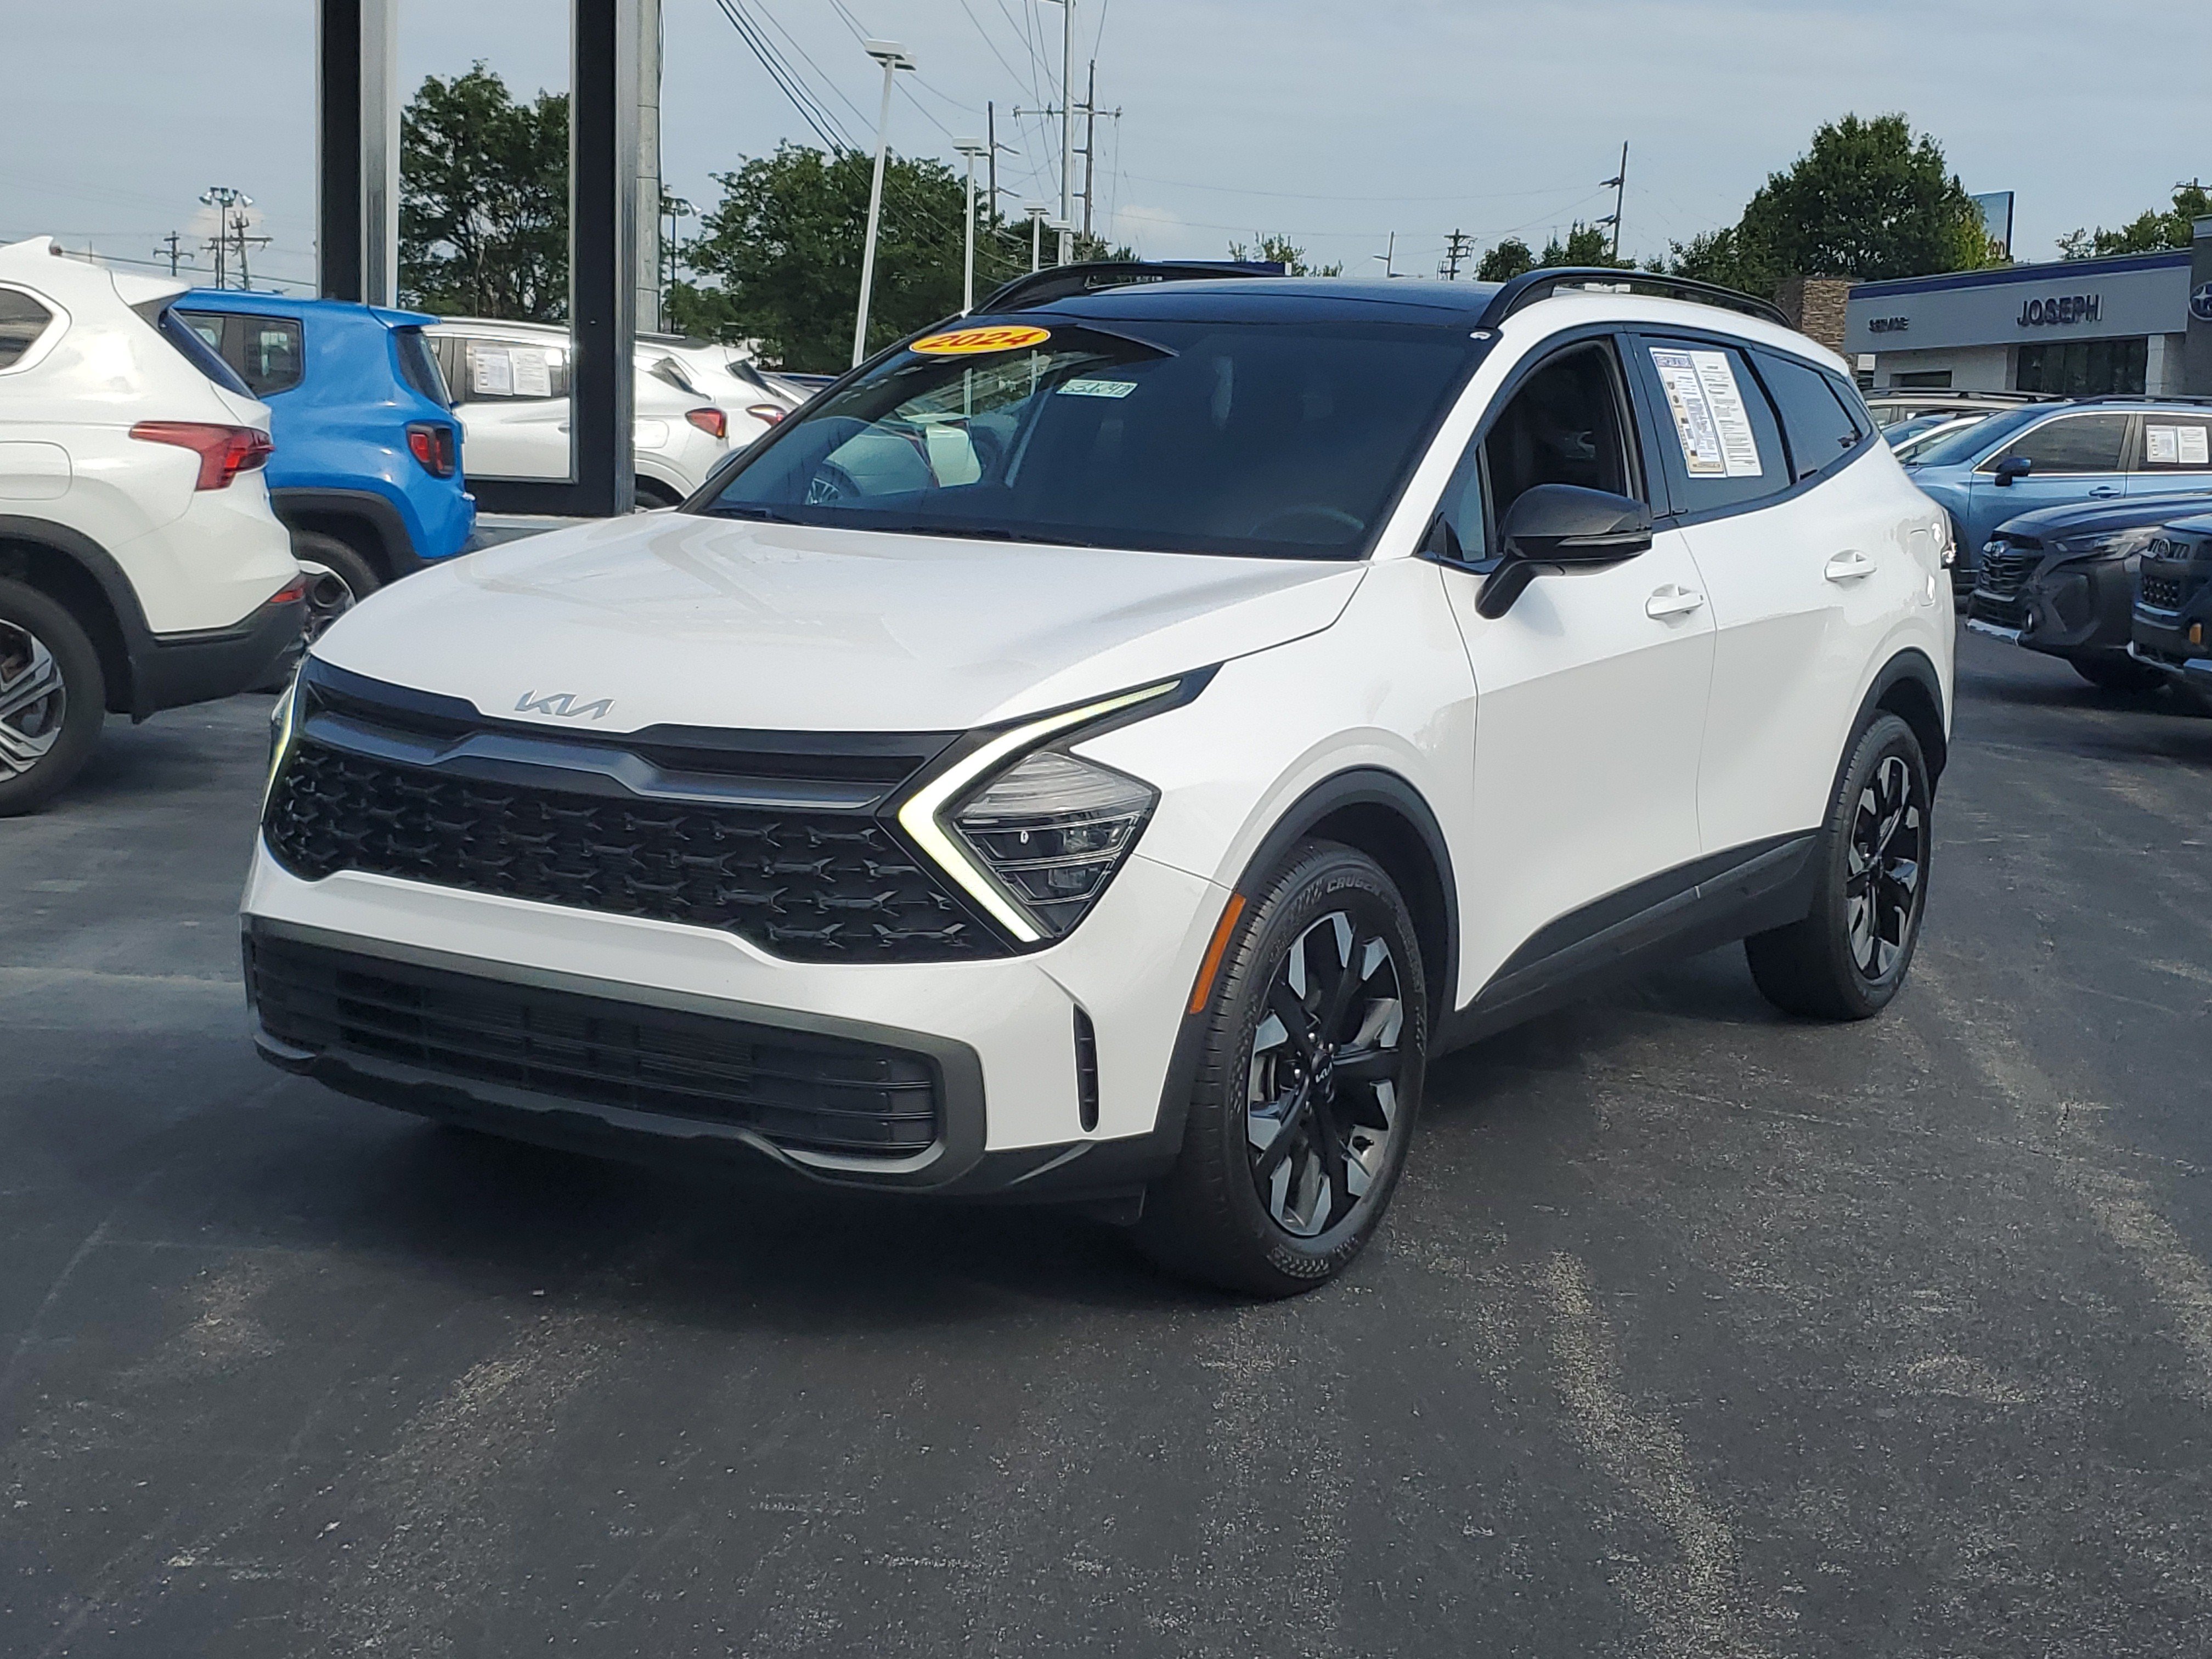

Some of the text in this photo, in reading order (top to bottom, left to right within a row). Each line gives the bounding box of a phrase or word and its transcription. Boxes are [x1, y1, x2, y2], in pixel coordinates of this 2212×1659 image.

[2017, 294, 2103, 327] JOSEPH
[919, 332, 1040, 349] 2024
[515, 689, 615, 720] KIA
